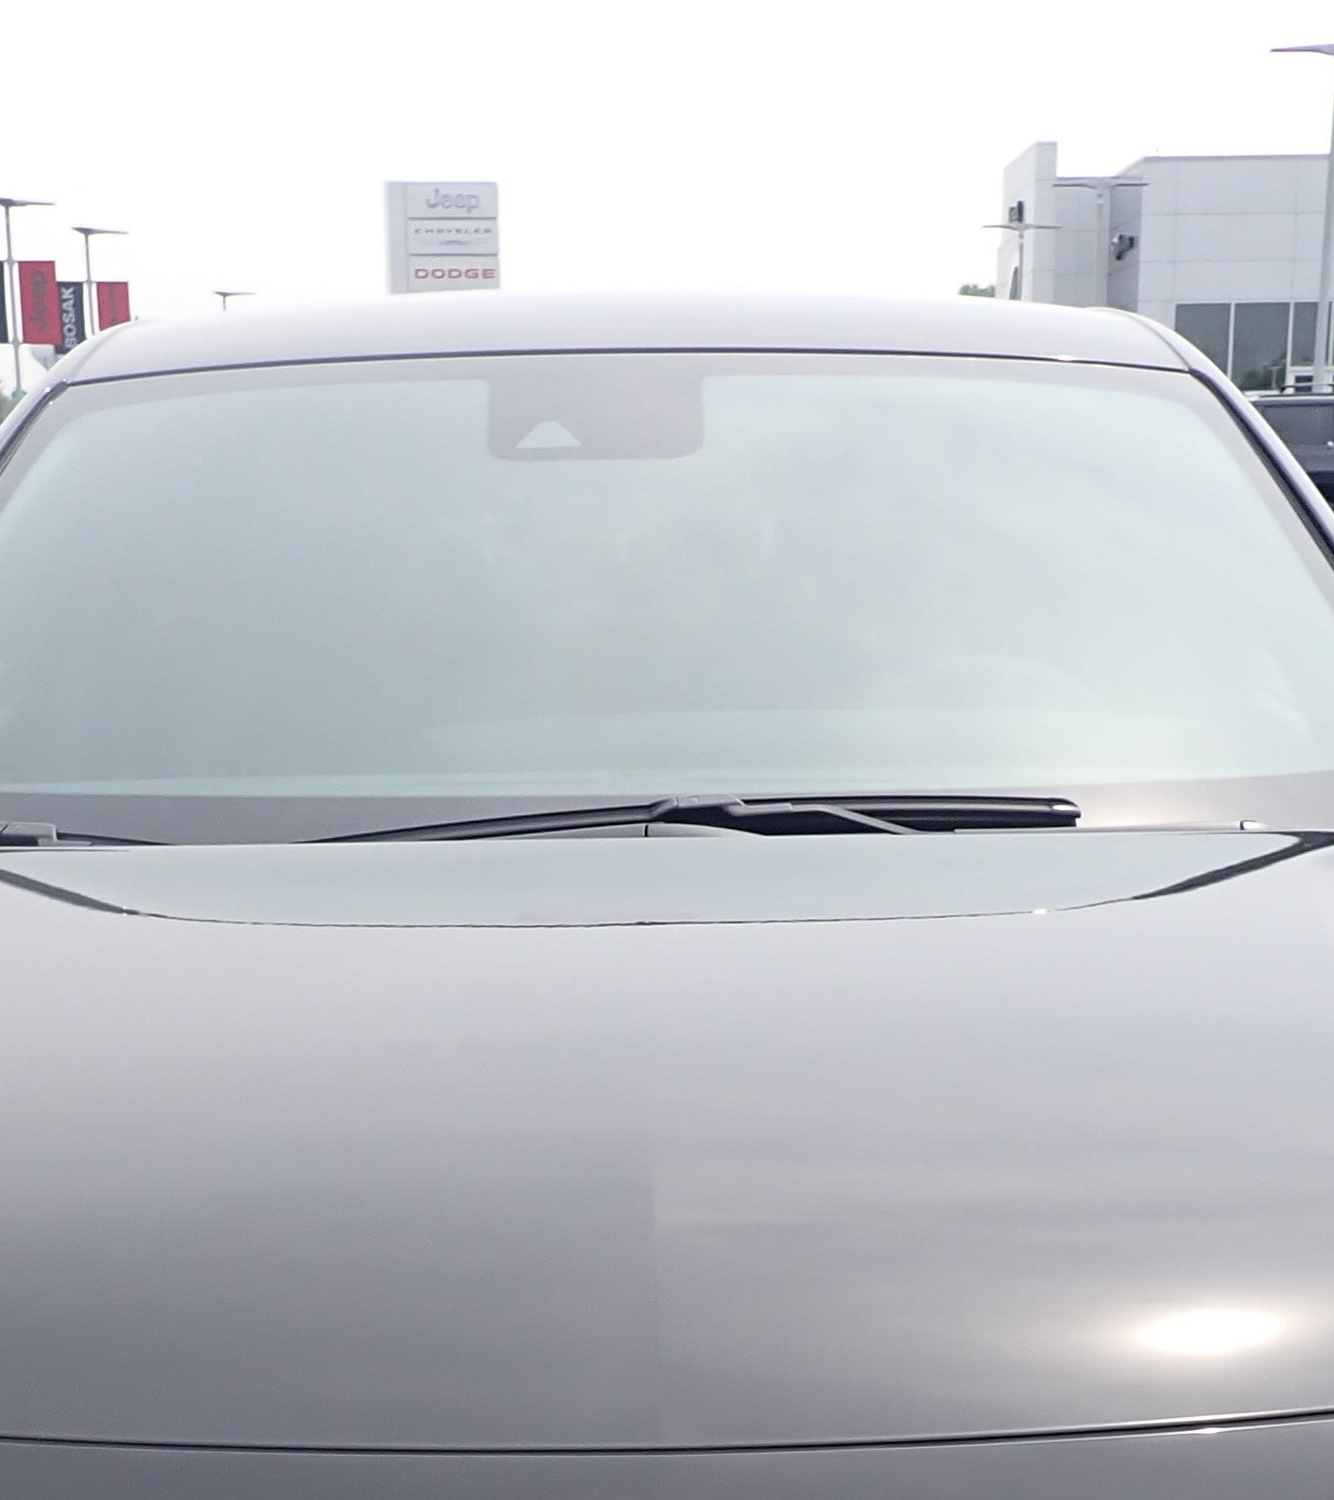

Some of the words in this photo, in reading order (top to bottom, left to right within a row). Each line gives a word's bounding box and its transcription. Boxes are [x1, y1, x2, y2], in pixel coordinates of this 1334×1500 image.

[426, 188, 480, 213] Jeep
[414, 268, 496, 280] DODGE
[60, 286, 78, 349] BOSAK
